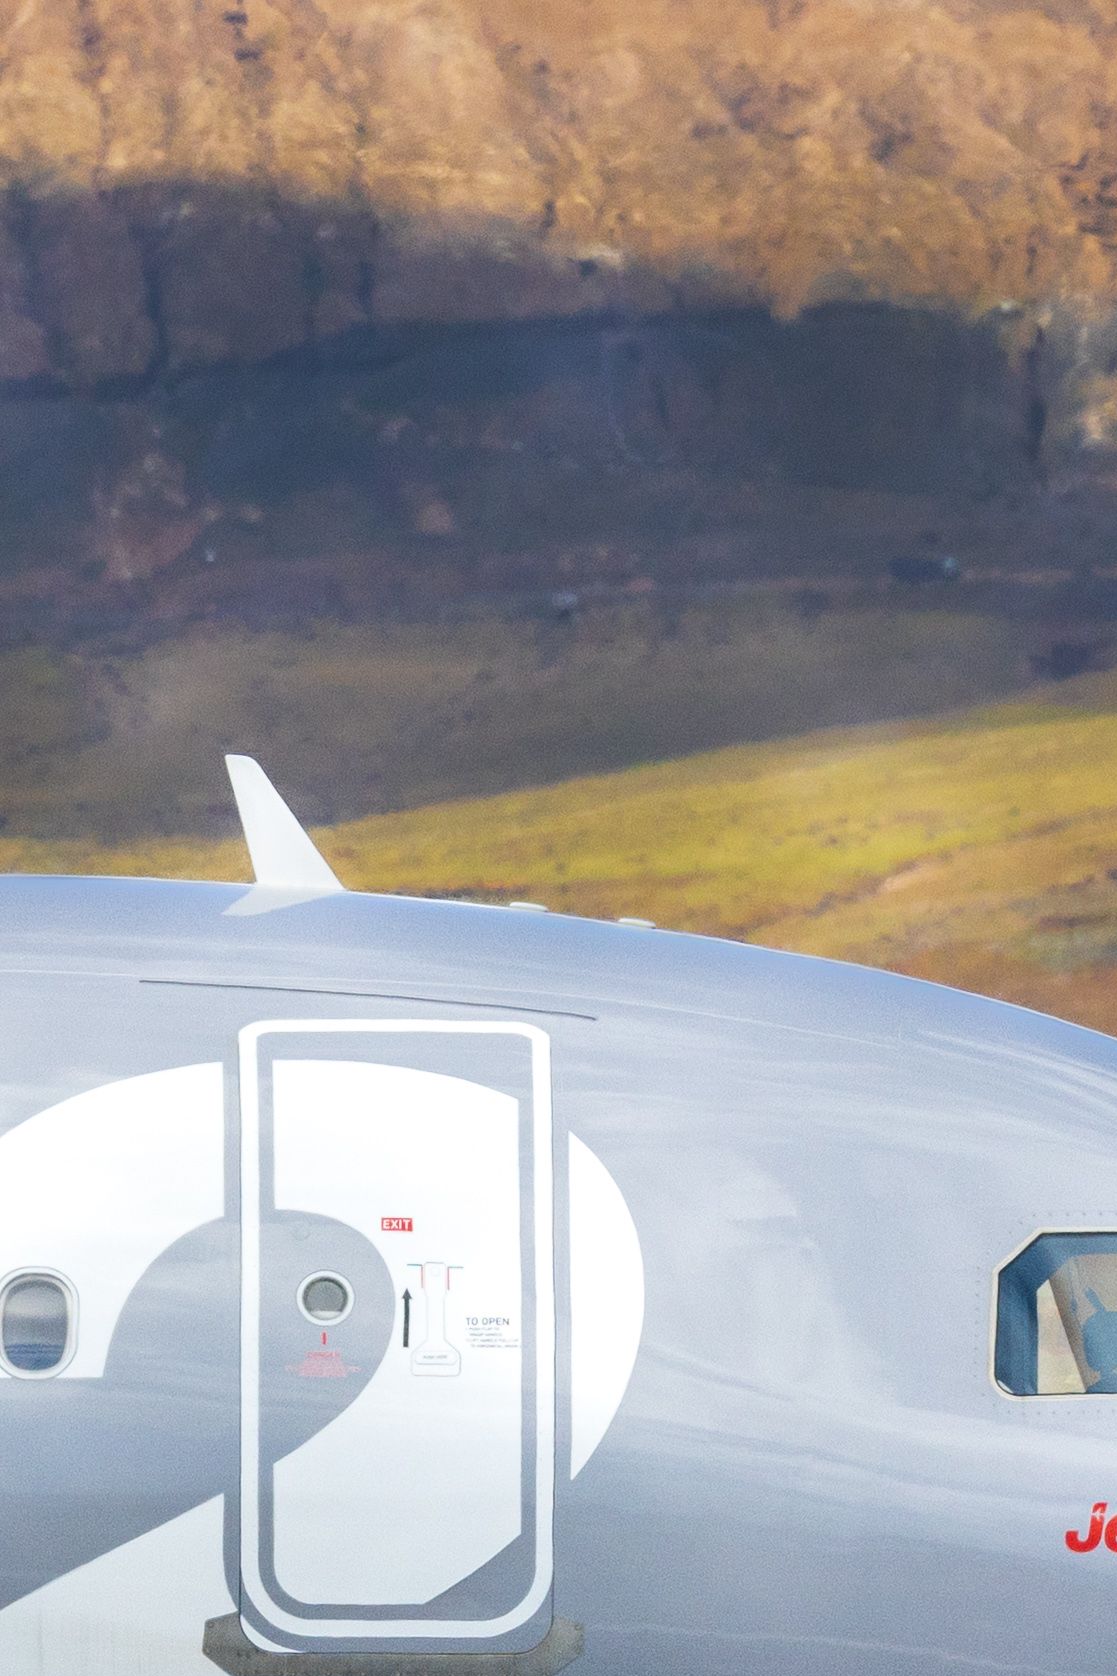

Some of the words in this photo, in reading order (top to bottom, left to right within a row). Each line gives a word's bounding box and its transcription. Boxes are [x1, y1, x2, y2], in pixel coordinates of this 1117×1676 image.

[382, 1218, 411, 1230] EXIT
[465, 1316, 479, 1326] TO
[481, 1316, 510, 1326] OPEN
